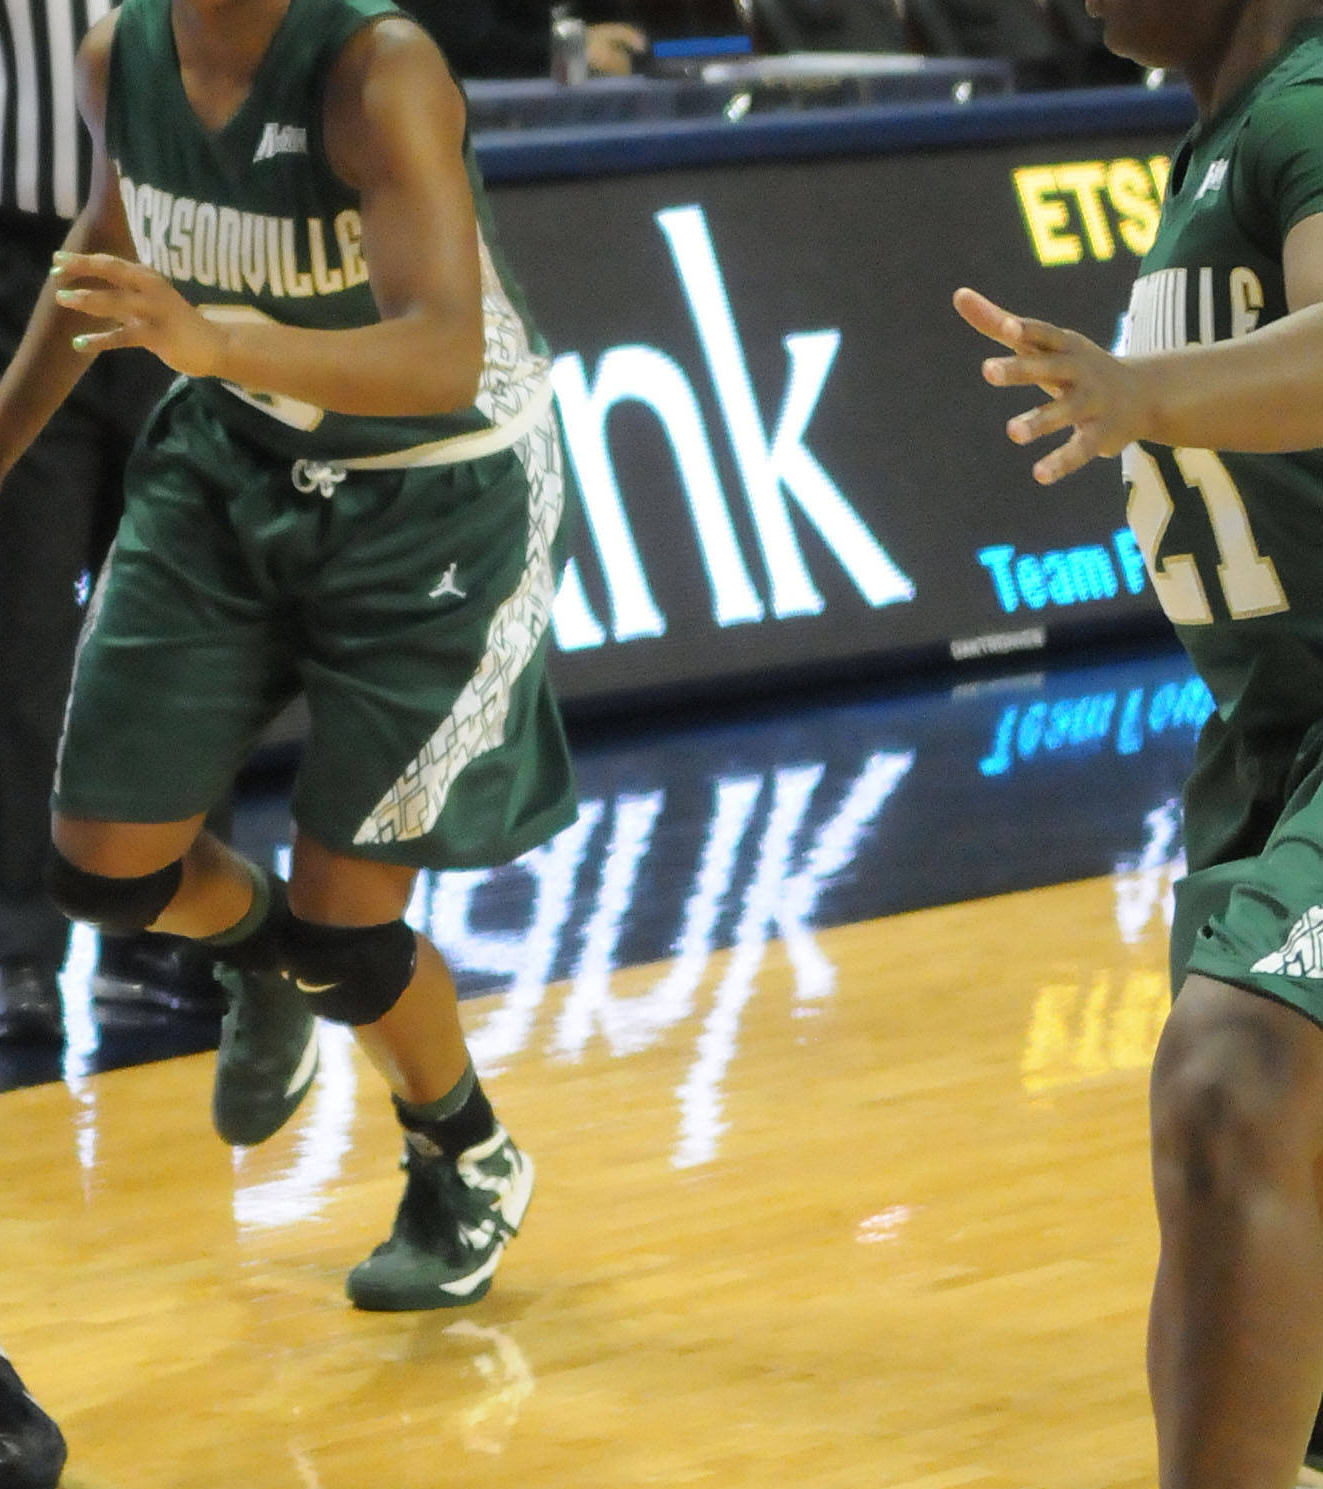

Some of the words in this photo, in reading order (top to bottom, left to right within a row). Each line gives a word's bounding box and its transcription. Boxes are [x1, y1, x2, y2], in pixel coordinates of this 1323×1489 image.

[550, 204, 916, 652] nk
[977, 544, 1119, 614] Team
[1122, 440, 1291, 626] 21
